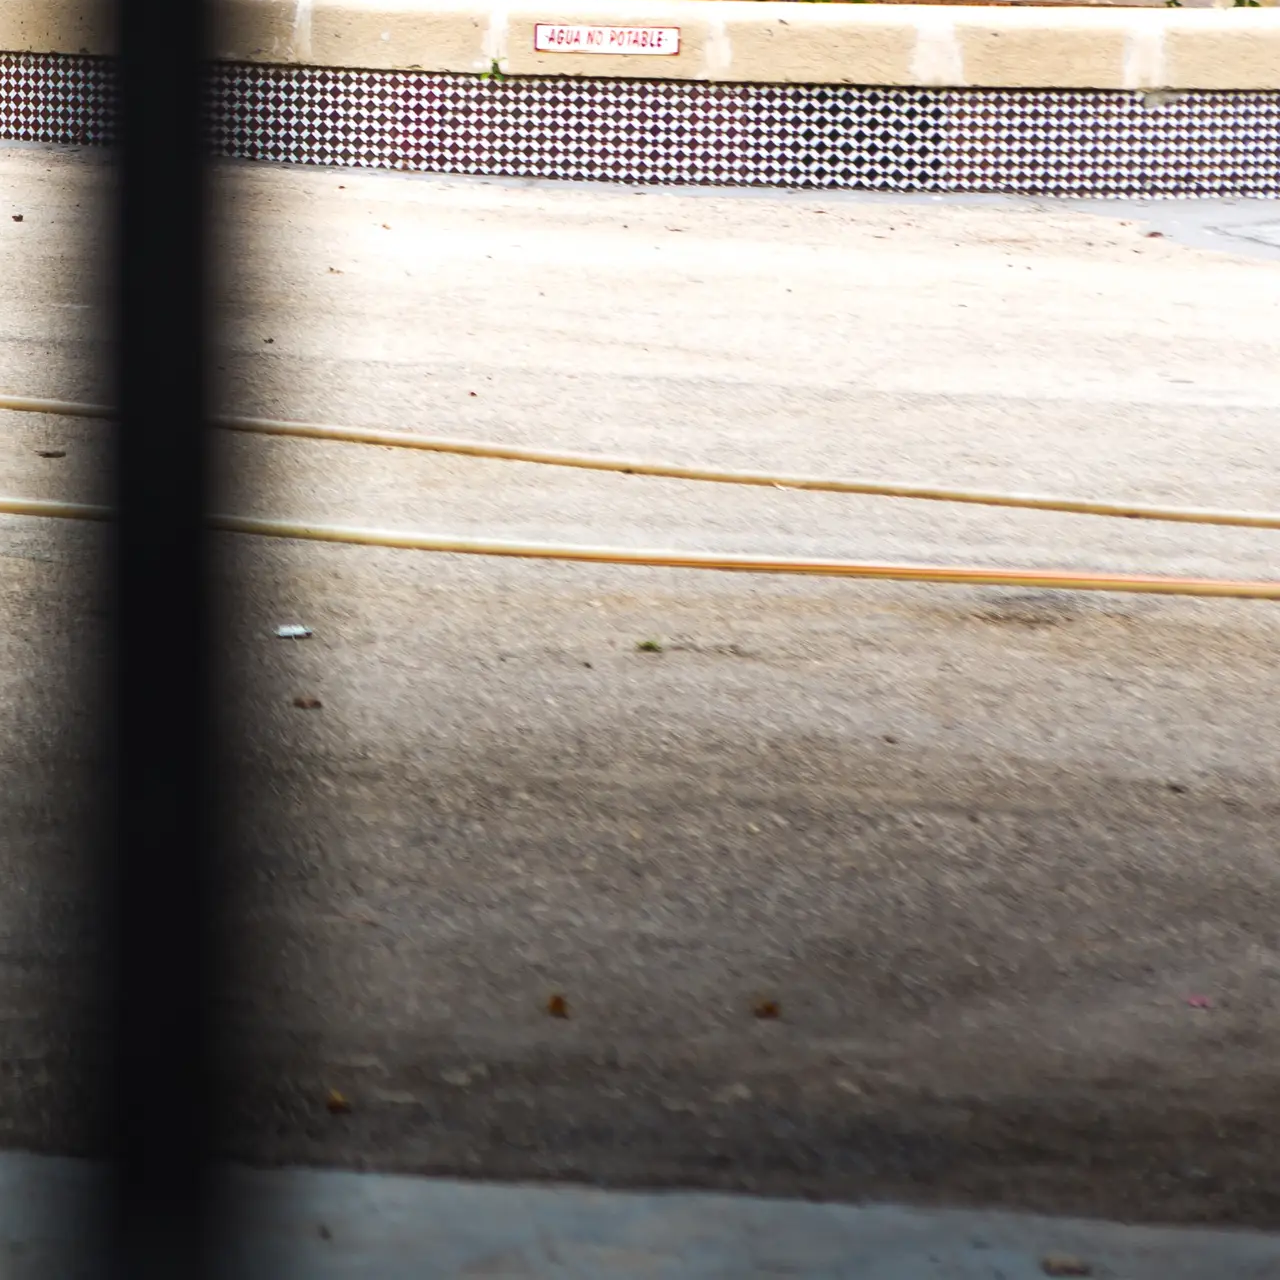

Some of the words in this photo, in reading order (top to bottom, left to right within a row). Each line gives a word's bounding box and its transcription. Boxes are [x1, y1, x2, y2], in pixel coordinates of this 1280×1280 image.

[548, 29, 581, 46] AGUA
[587, 30, 604, 46] NO
[609, 30, 664, 48] POTABLE
